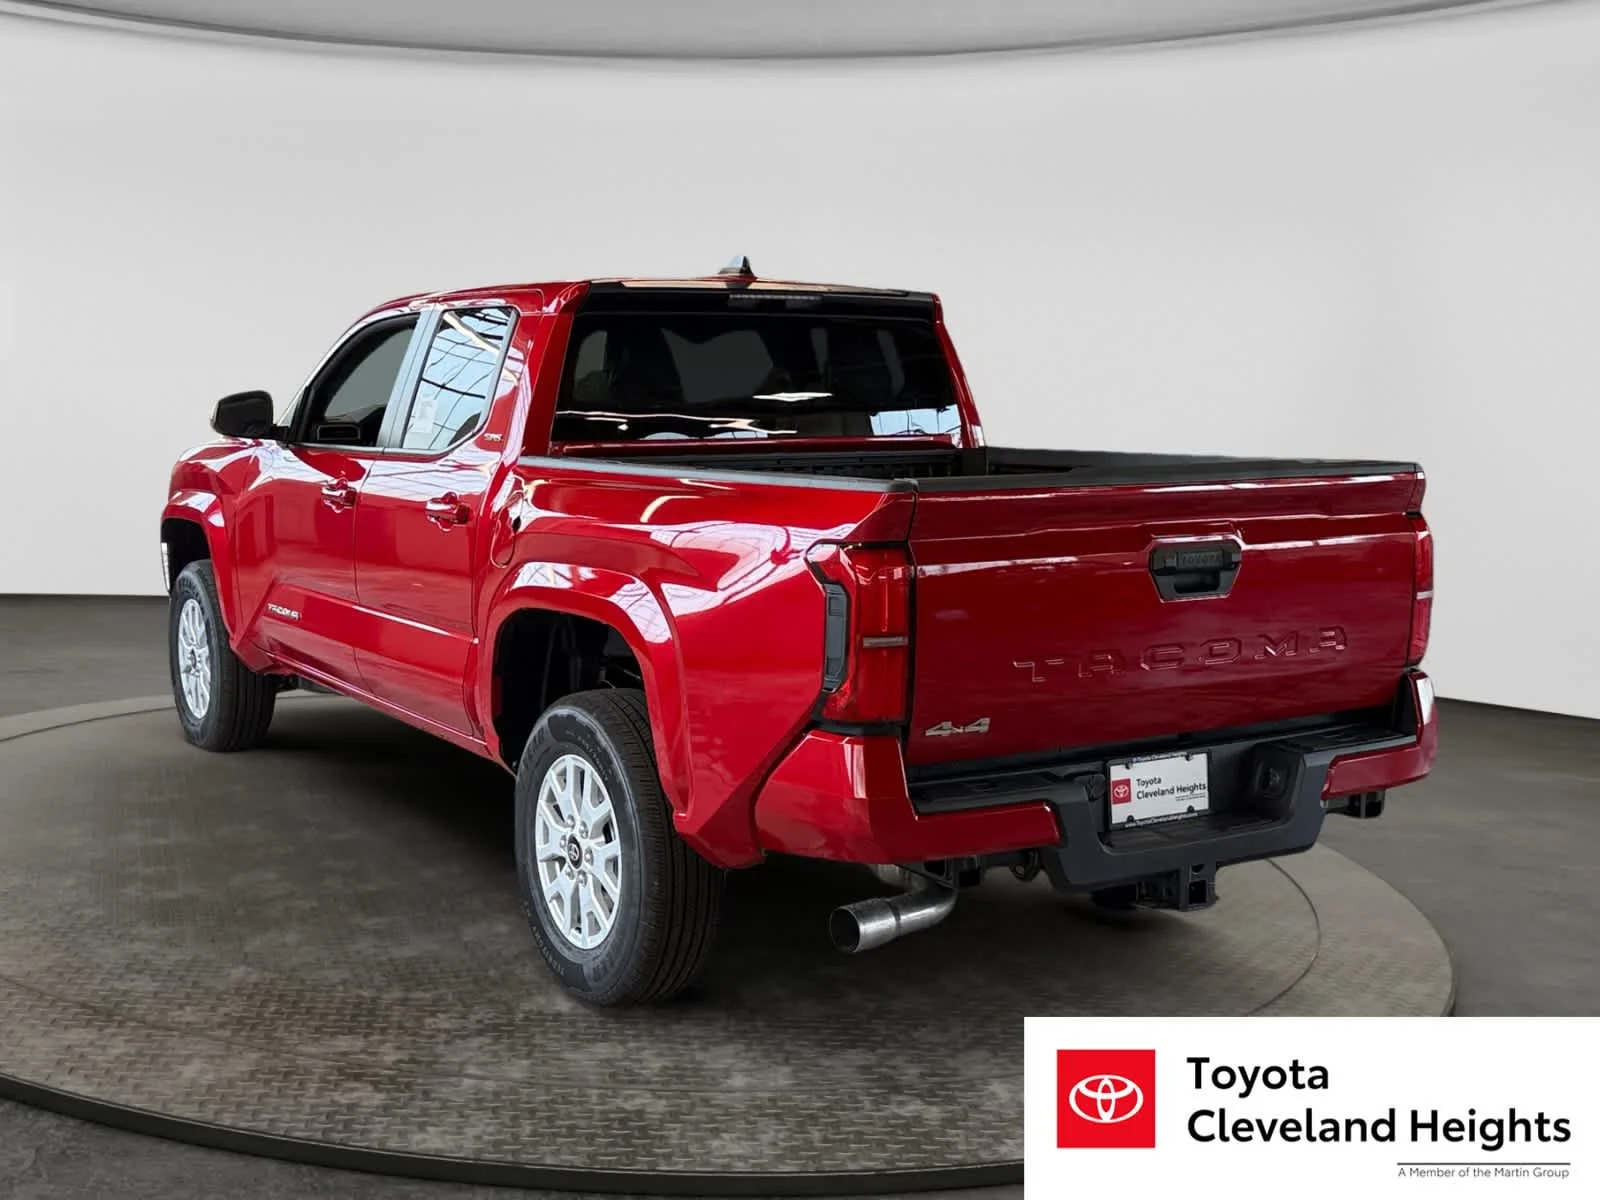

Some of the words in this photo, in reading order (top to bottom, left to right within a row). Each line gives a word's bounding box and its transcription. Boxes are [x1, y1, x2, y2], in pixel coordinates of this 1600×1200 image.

[1012, 625, 1347, 683] TACOMA
[1136, 777, 1162, 788] Toyota
[1136, 788, 1175, 800] Cleveland
[1176, 783, 1206, 794] Heights
